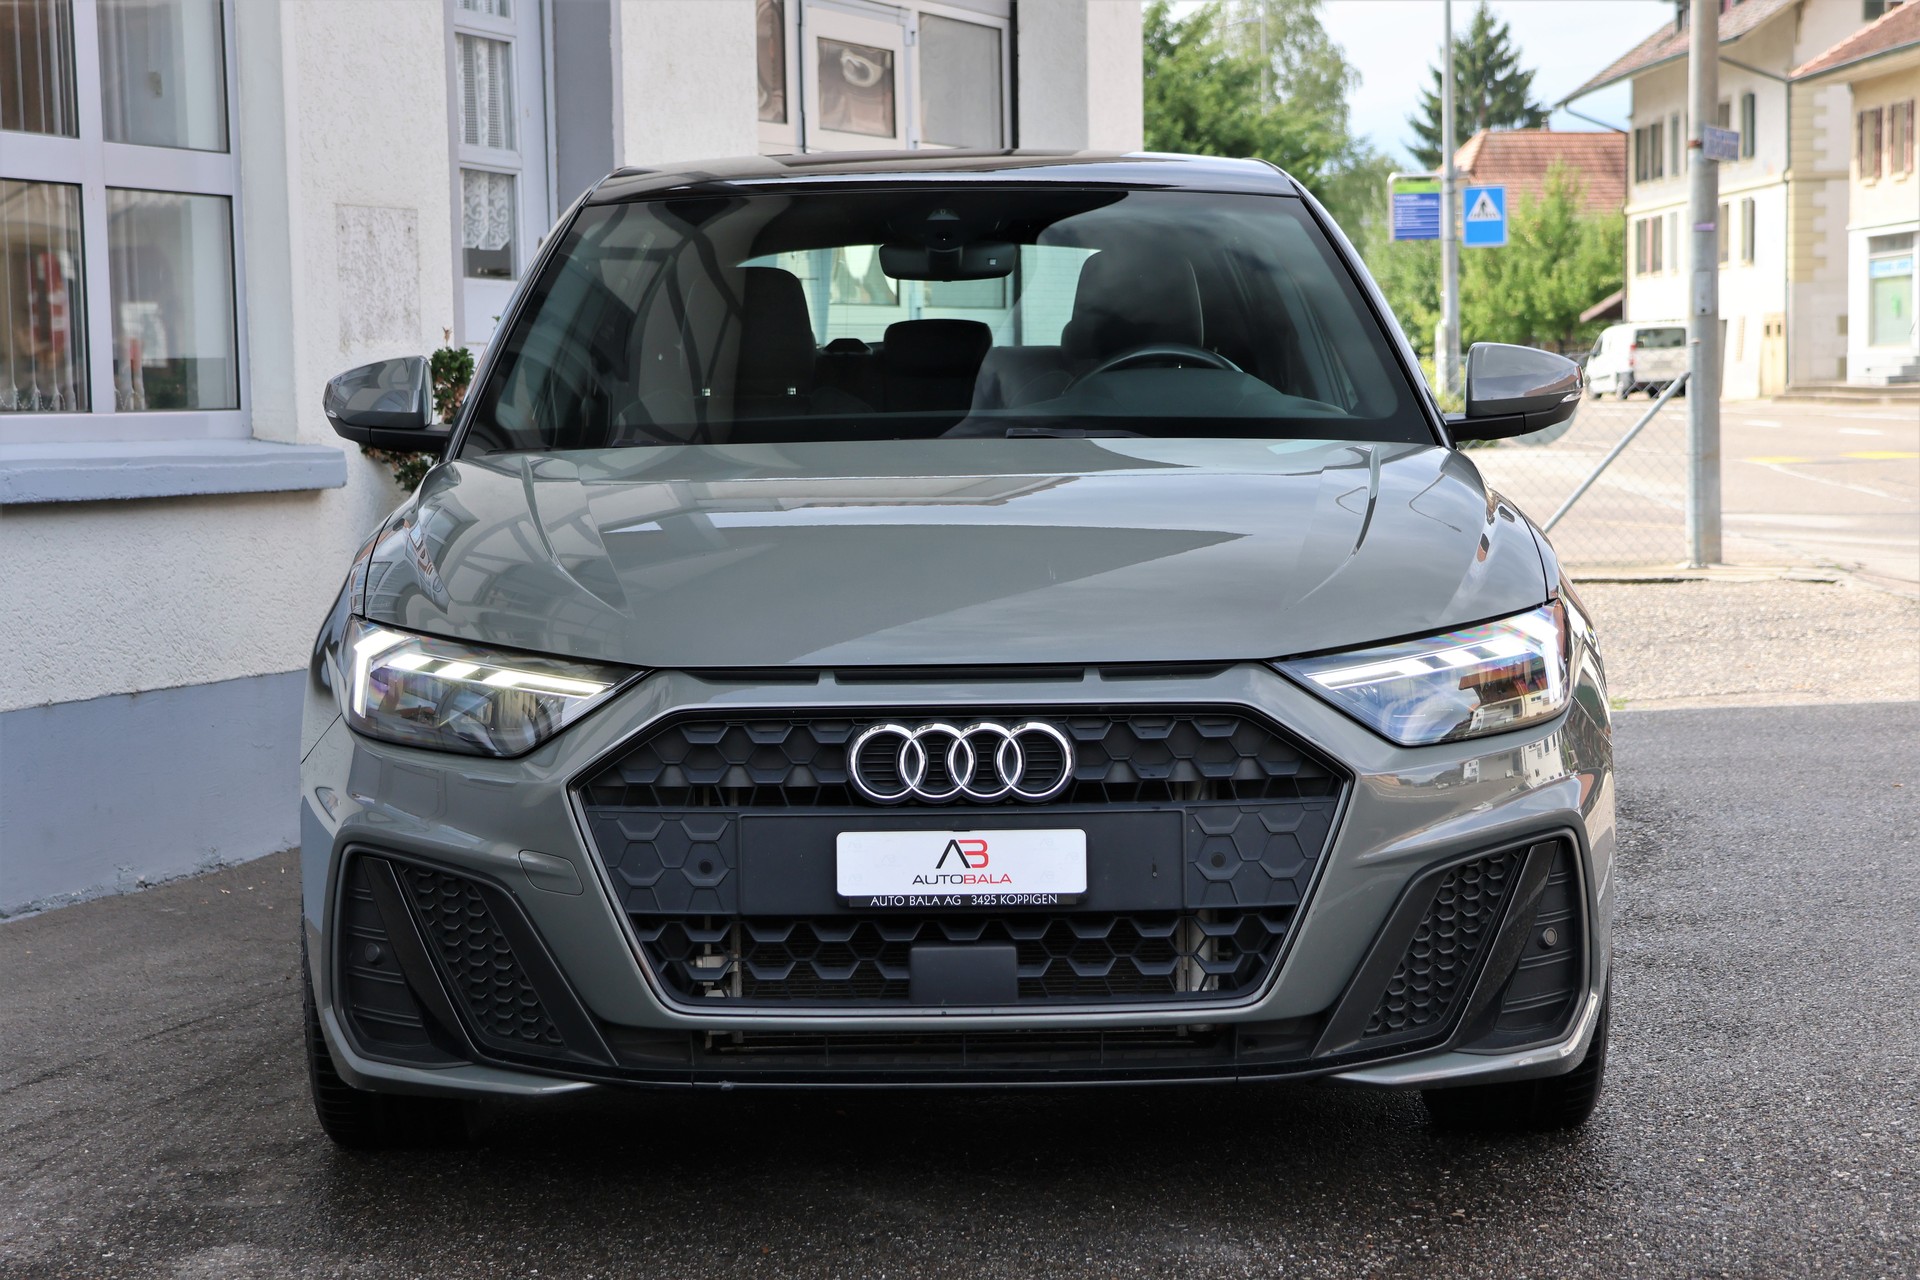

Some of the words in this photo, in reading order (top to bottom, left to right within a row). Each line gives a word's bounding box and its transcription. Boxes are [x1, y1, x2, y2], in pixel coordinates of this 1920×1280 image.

[912, 873, 1012, 885] AUTOBALA
[870, 895, 905, 906] AUTO
[909, 895, 940, 906] BALA
[943, 894, 962, 906] AG
[971, 894, 997, 905] 3425
[1000, 893, 1058, 905] KOPPIGEN
